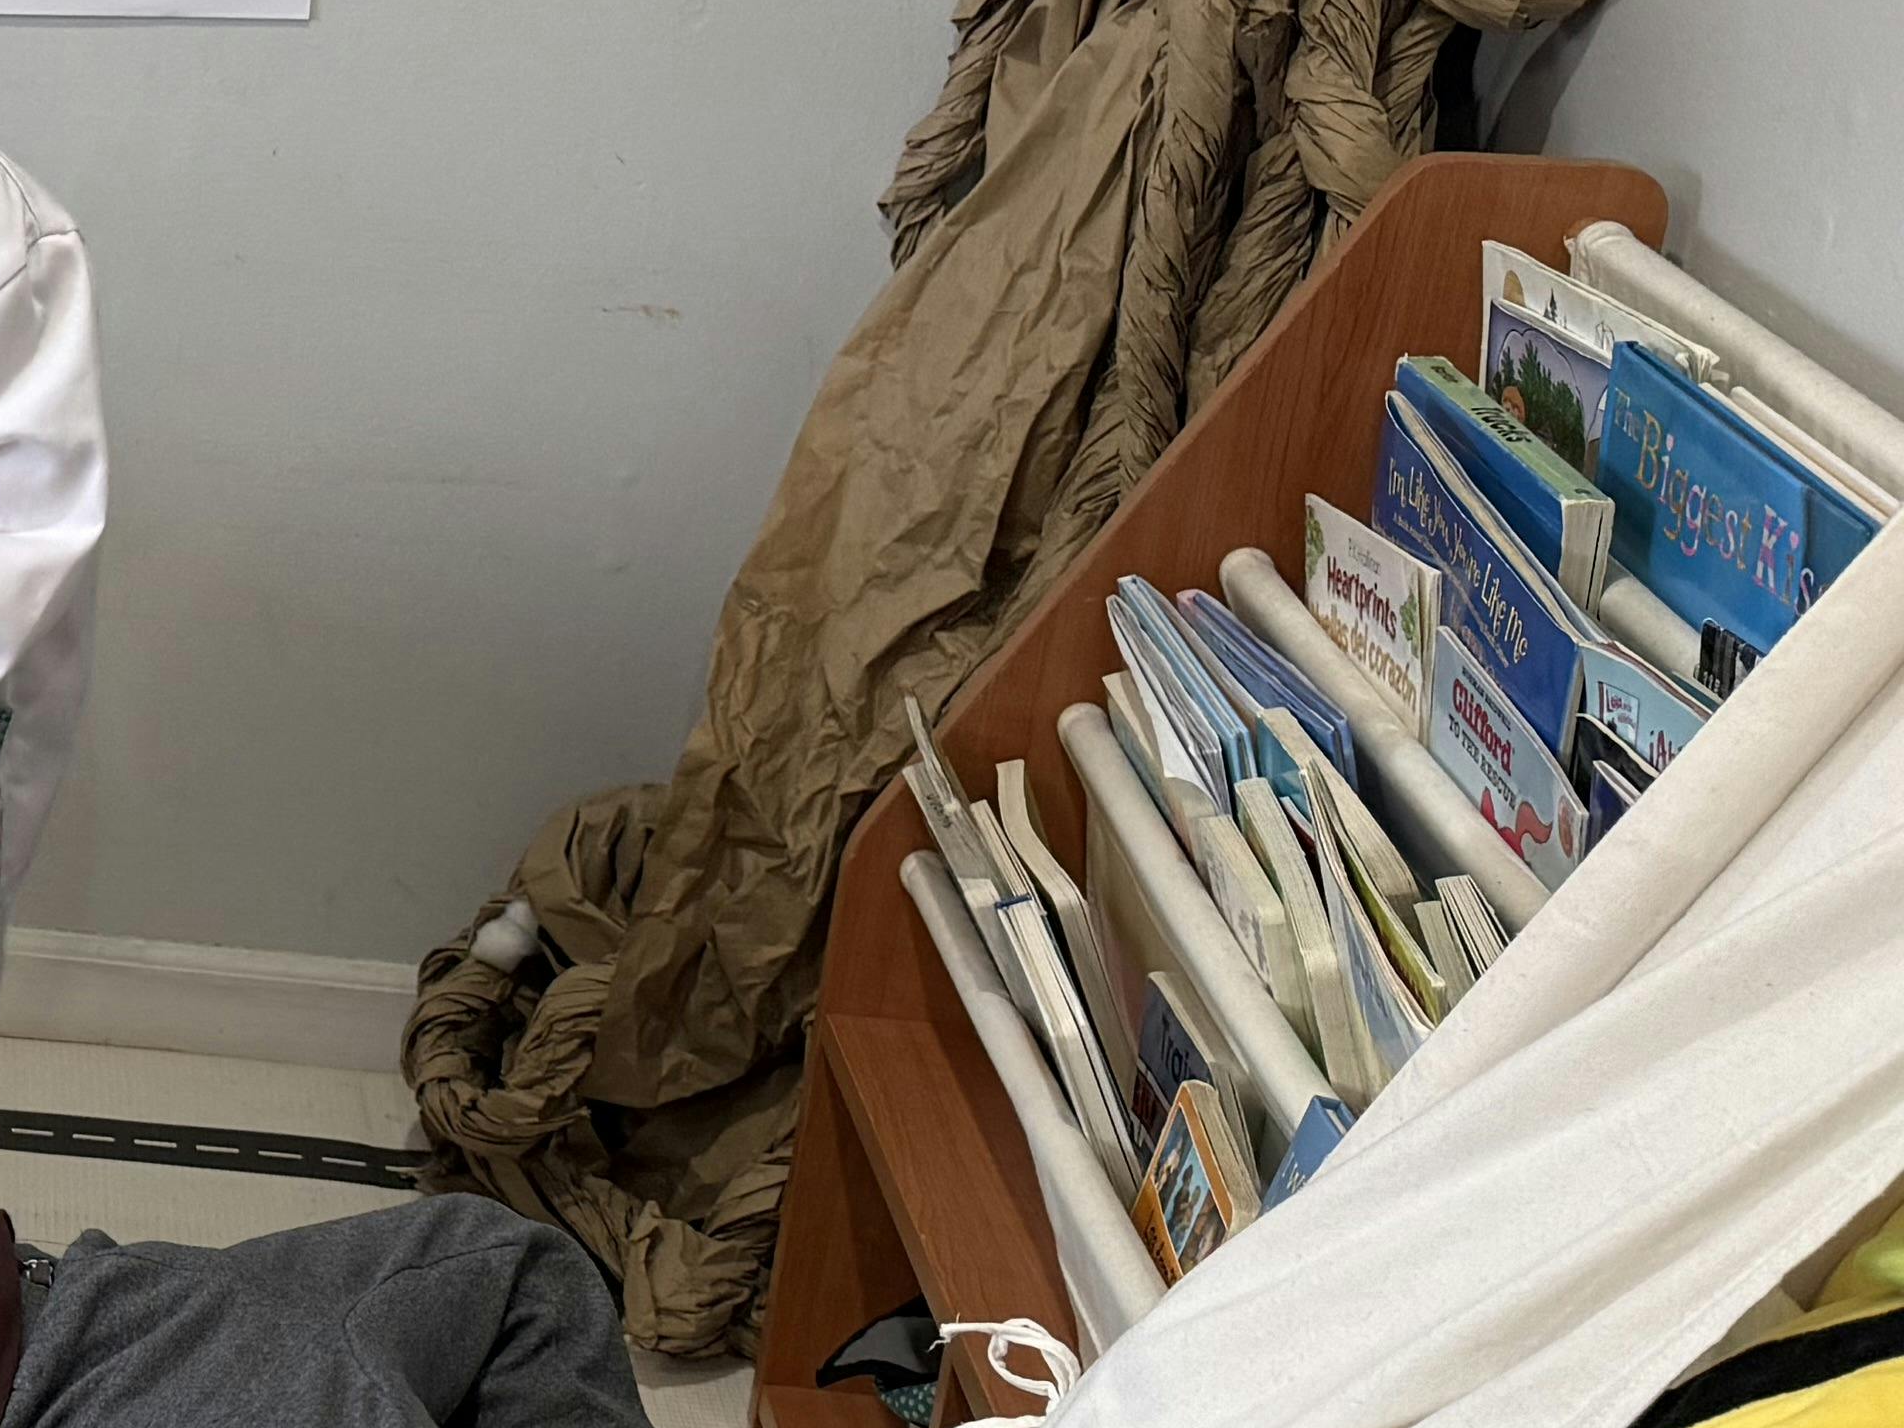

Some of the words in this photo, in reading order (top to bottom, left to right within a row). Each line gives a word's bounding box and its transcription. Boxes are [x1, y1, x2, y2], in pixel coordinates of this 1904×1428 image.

[1634, 409, 1753, 571] Biggest
[1753, 503, 1830, 617] Kis
[1326, 555, 1398, 641] Heartprints
[1407, 465, 1431, 529] Like
[1480, 562, 1507, 638] Like
[1504, 605, 1530, 665] Me
[1350, 615, 1369, 666] del
[1368, 641, 1418, 716] corazón
[1448, 713, 1460, 739] TO
[1452, 677, 1513, 778] Clifford
[1160, 1013, 1198, 1085] Trai
